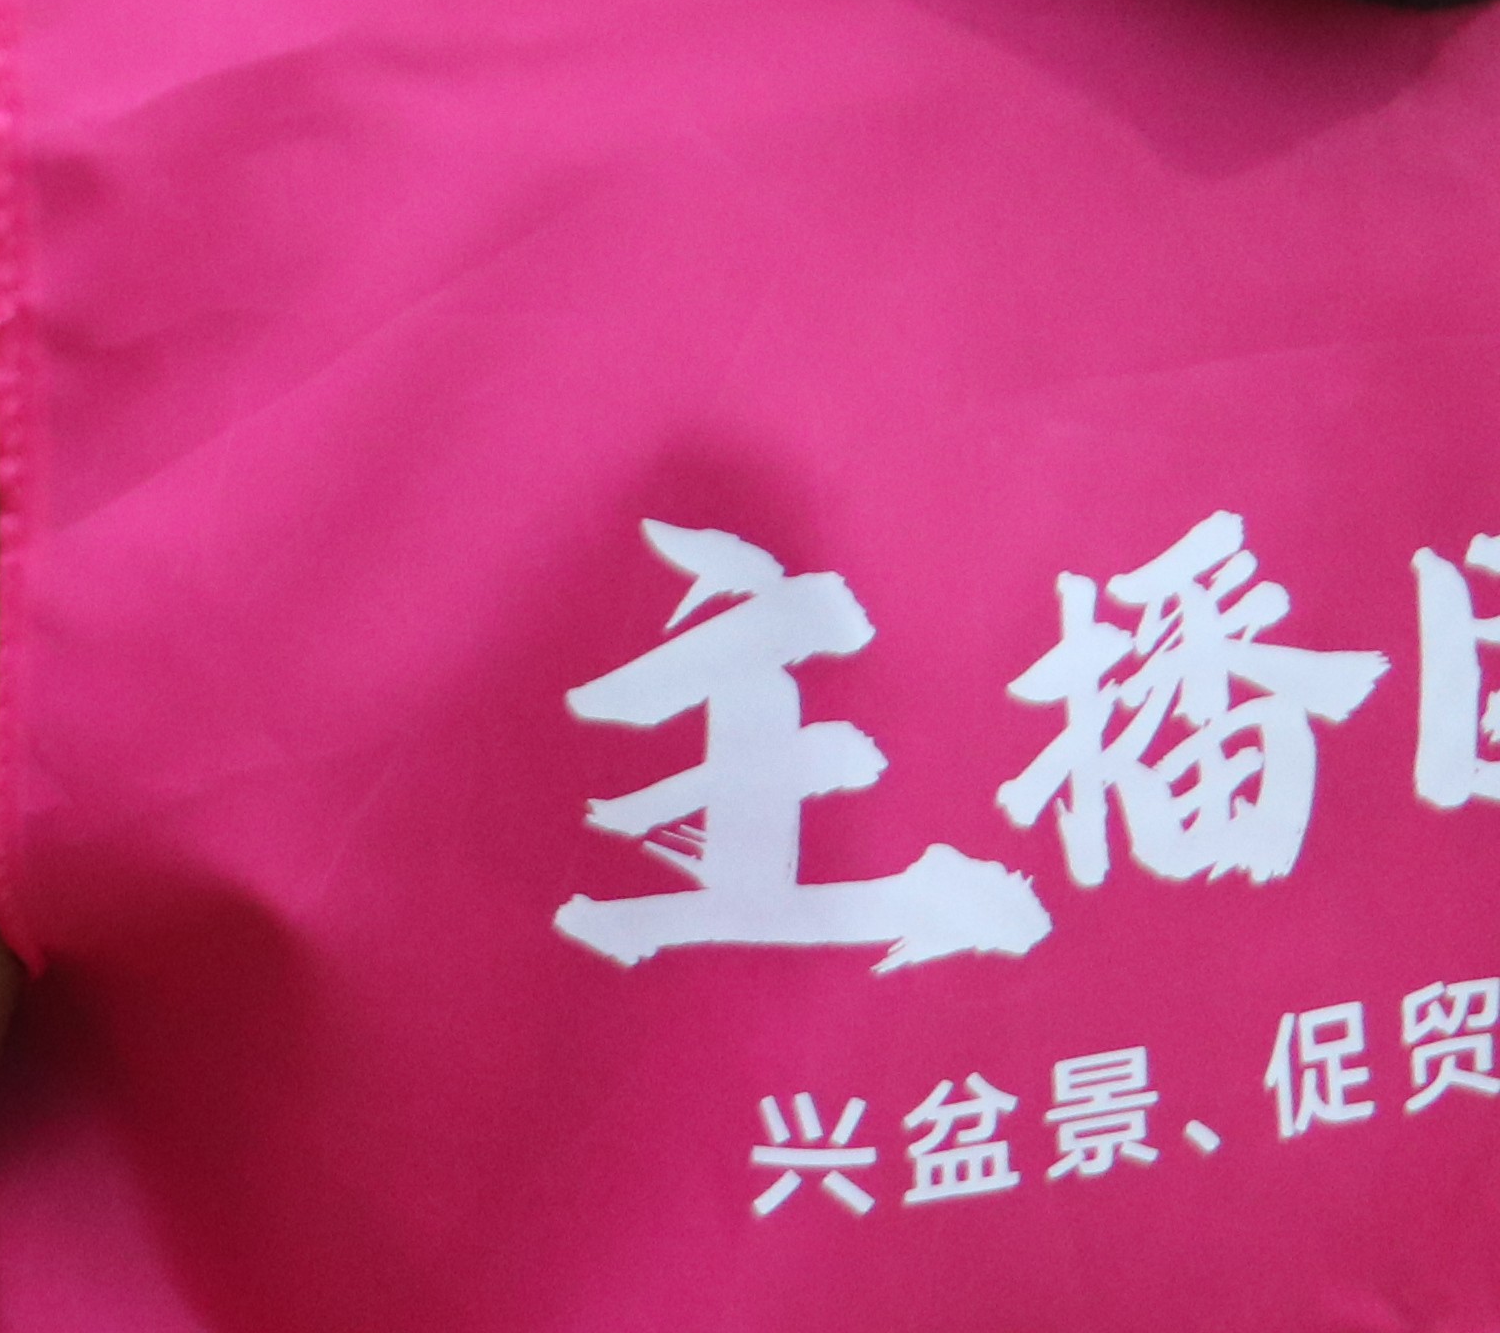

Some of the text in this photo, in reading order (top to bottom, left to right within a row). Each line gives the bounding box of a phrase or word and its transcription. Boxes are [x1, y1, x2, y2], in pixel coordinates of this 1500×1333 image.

[751, 976, 1500, 1217] 兴盆景、促贸
